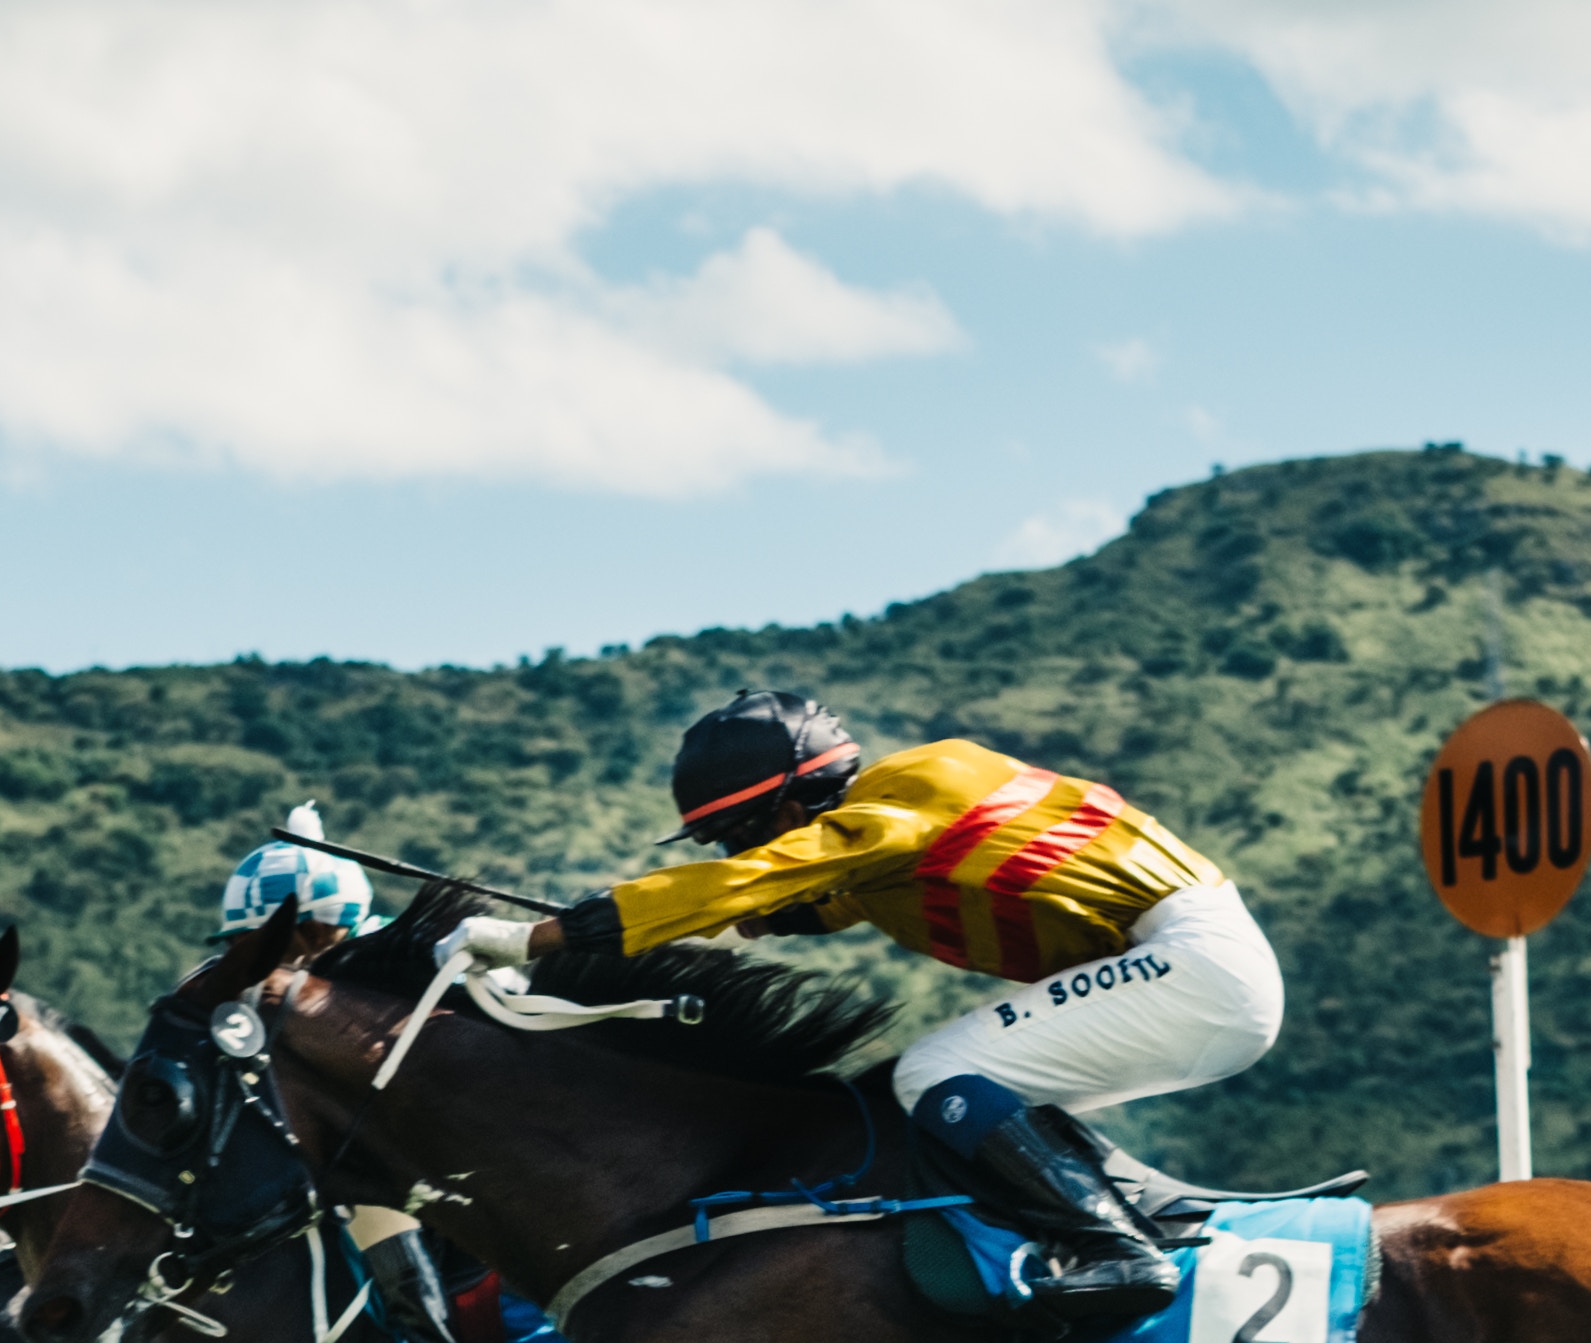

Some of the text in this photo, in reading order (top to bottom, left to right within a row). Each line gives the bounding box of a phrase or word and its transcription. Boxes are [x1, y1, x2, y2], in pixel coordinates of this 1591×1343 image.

[1438, 747, 1583, 887] 1400
[217, 1013, 253, 1050] 2
[994, 1002, 1031, 1028] B.
